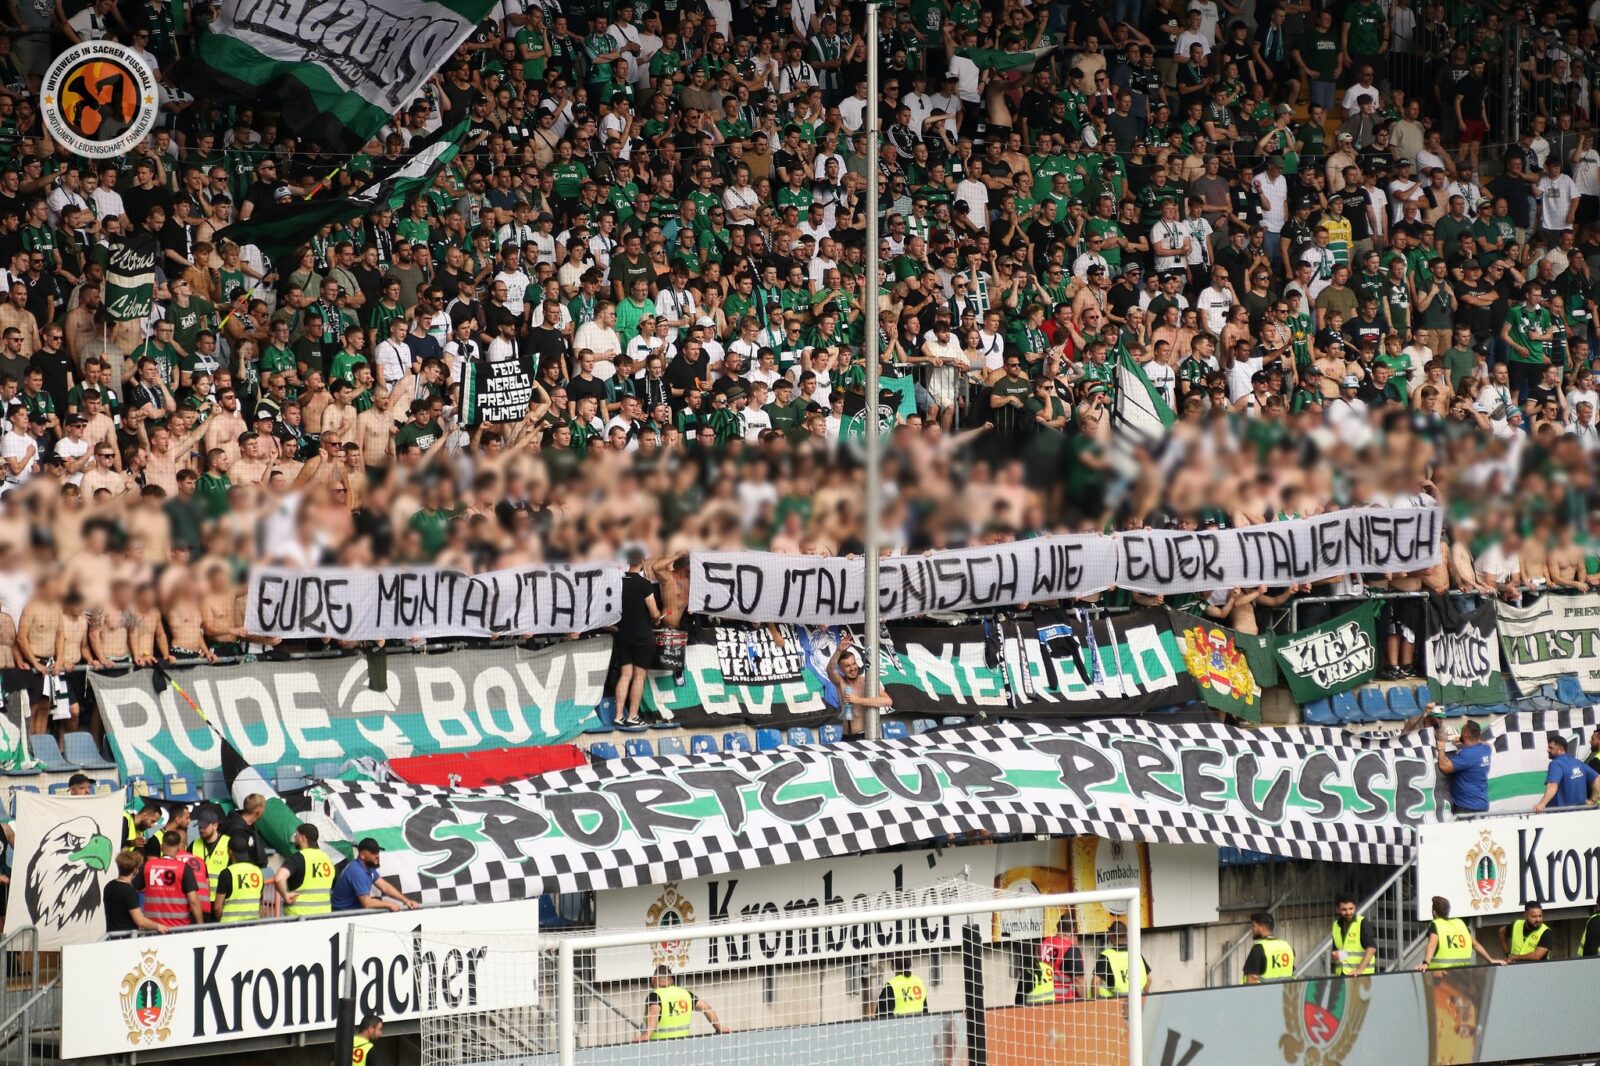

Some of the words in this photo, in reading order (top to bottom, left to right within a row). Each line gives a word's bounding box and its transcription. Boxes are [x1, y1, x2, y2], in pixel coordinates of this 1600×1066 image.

[491, 360, 521, 376] FEDE
[477, 388, 532, 407] PREUSSE
[482, 403, 530, 421] MÜNSTE
[1122, 534, 1224, 584] EUER
[1236, 511, 1435, 579] ITALIENISCH
[702, 562, 763, 614] SO
[779, 553, 1017, 617] ITALENISCH
[1031, 543, 1083, 595] WIE
[257, 577, 352, 635] EURE
[376, 563, 614, 633] MENTALITÄT:
[1312, 646, 1374, 688] CREW
[99, 673, 346, 776] RUDE
[404, 751, 1020, 879] SPORTCLUB
[150, 868, 176, 887] K9
[312, 862, 331, 878] K9
[1097, 864, 1140, 884] Krombacher
[237, 872, 260, 889] K9
[706, 864, 959, 964] Krombacher
[1447, 934, 1467, 949] K9
[1272, 952, 1290, 968] K9
[192, 923, 488, 1038] Krombacher
[1120, 968, 1129, 984] K
[901, 985, 922, 1002] K9
[669, 1000, 688, 1016] K9
